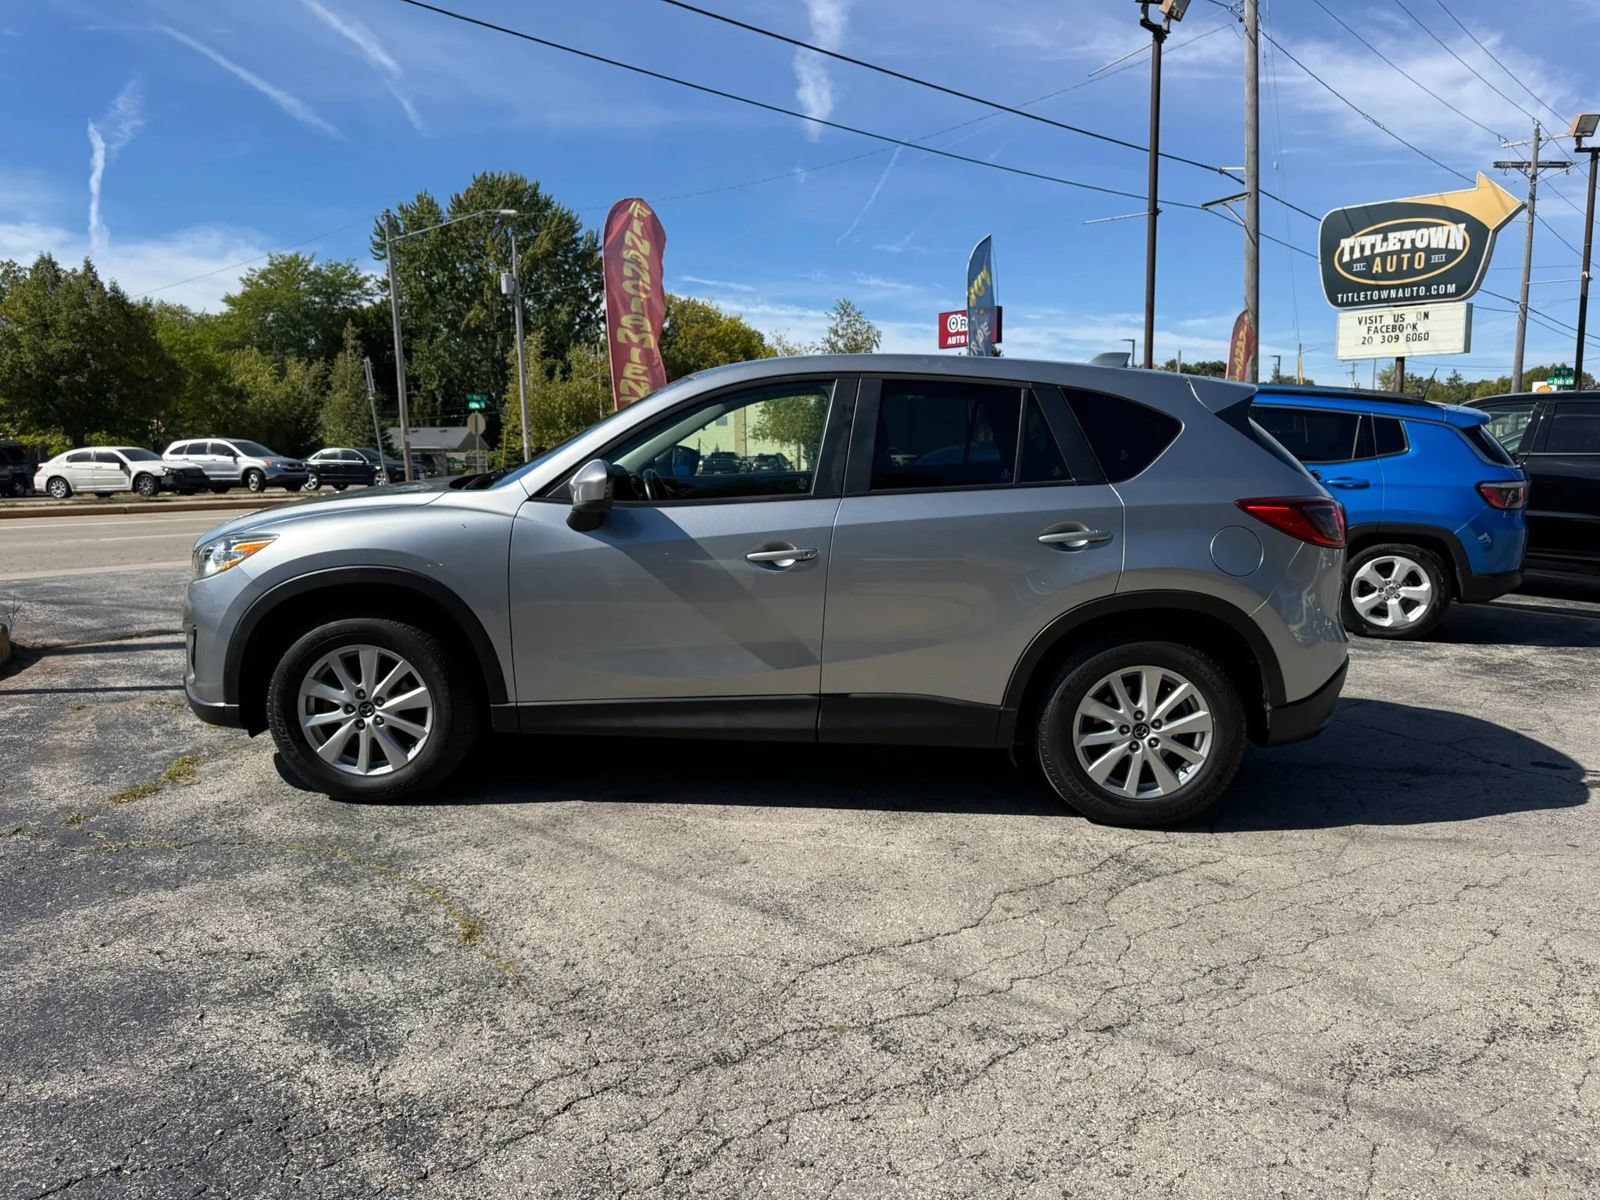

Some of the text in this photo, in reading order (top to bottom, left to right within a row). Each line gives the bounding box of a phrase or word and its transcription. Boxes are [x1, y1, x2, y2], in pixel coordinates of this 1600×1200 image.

[1340, 223, 1467, 263] TITLETOWN
[1372, 252, 1425, 274] AUTO
[1337, 283, 1456, 303] TITLETOWNAUTO.COM
[1358, 311, 1430, 326] VISIT US ON
[1367, 322, 1418, 335] FACEBOOK
[947, 335, 965, 345] AUTO
[1380, 334, 1400, 344] 309
[1405, 331, 1430, 342] 6060
